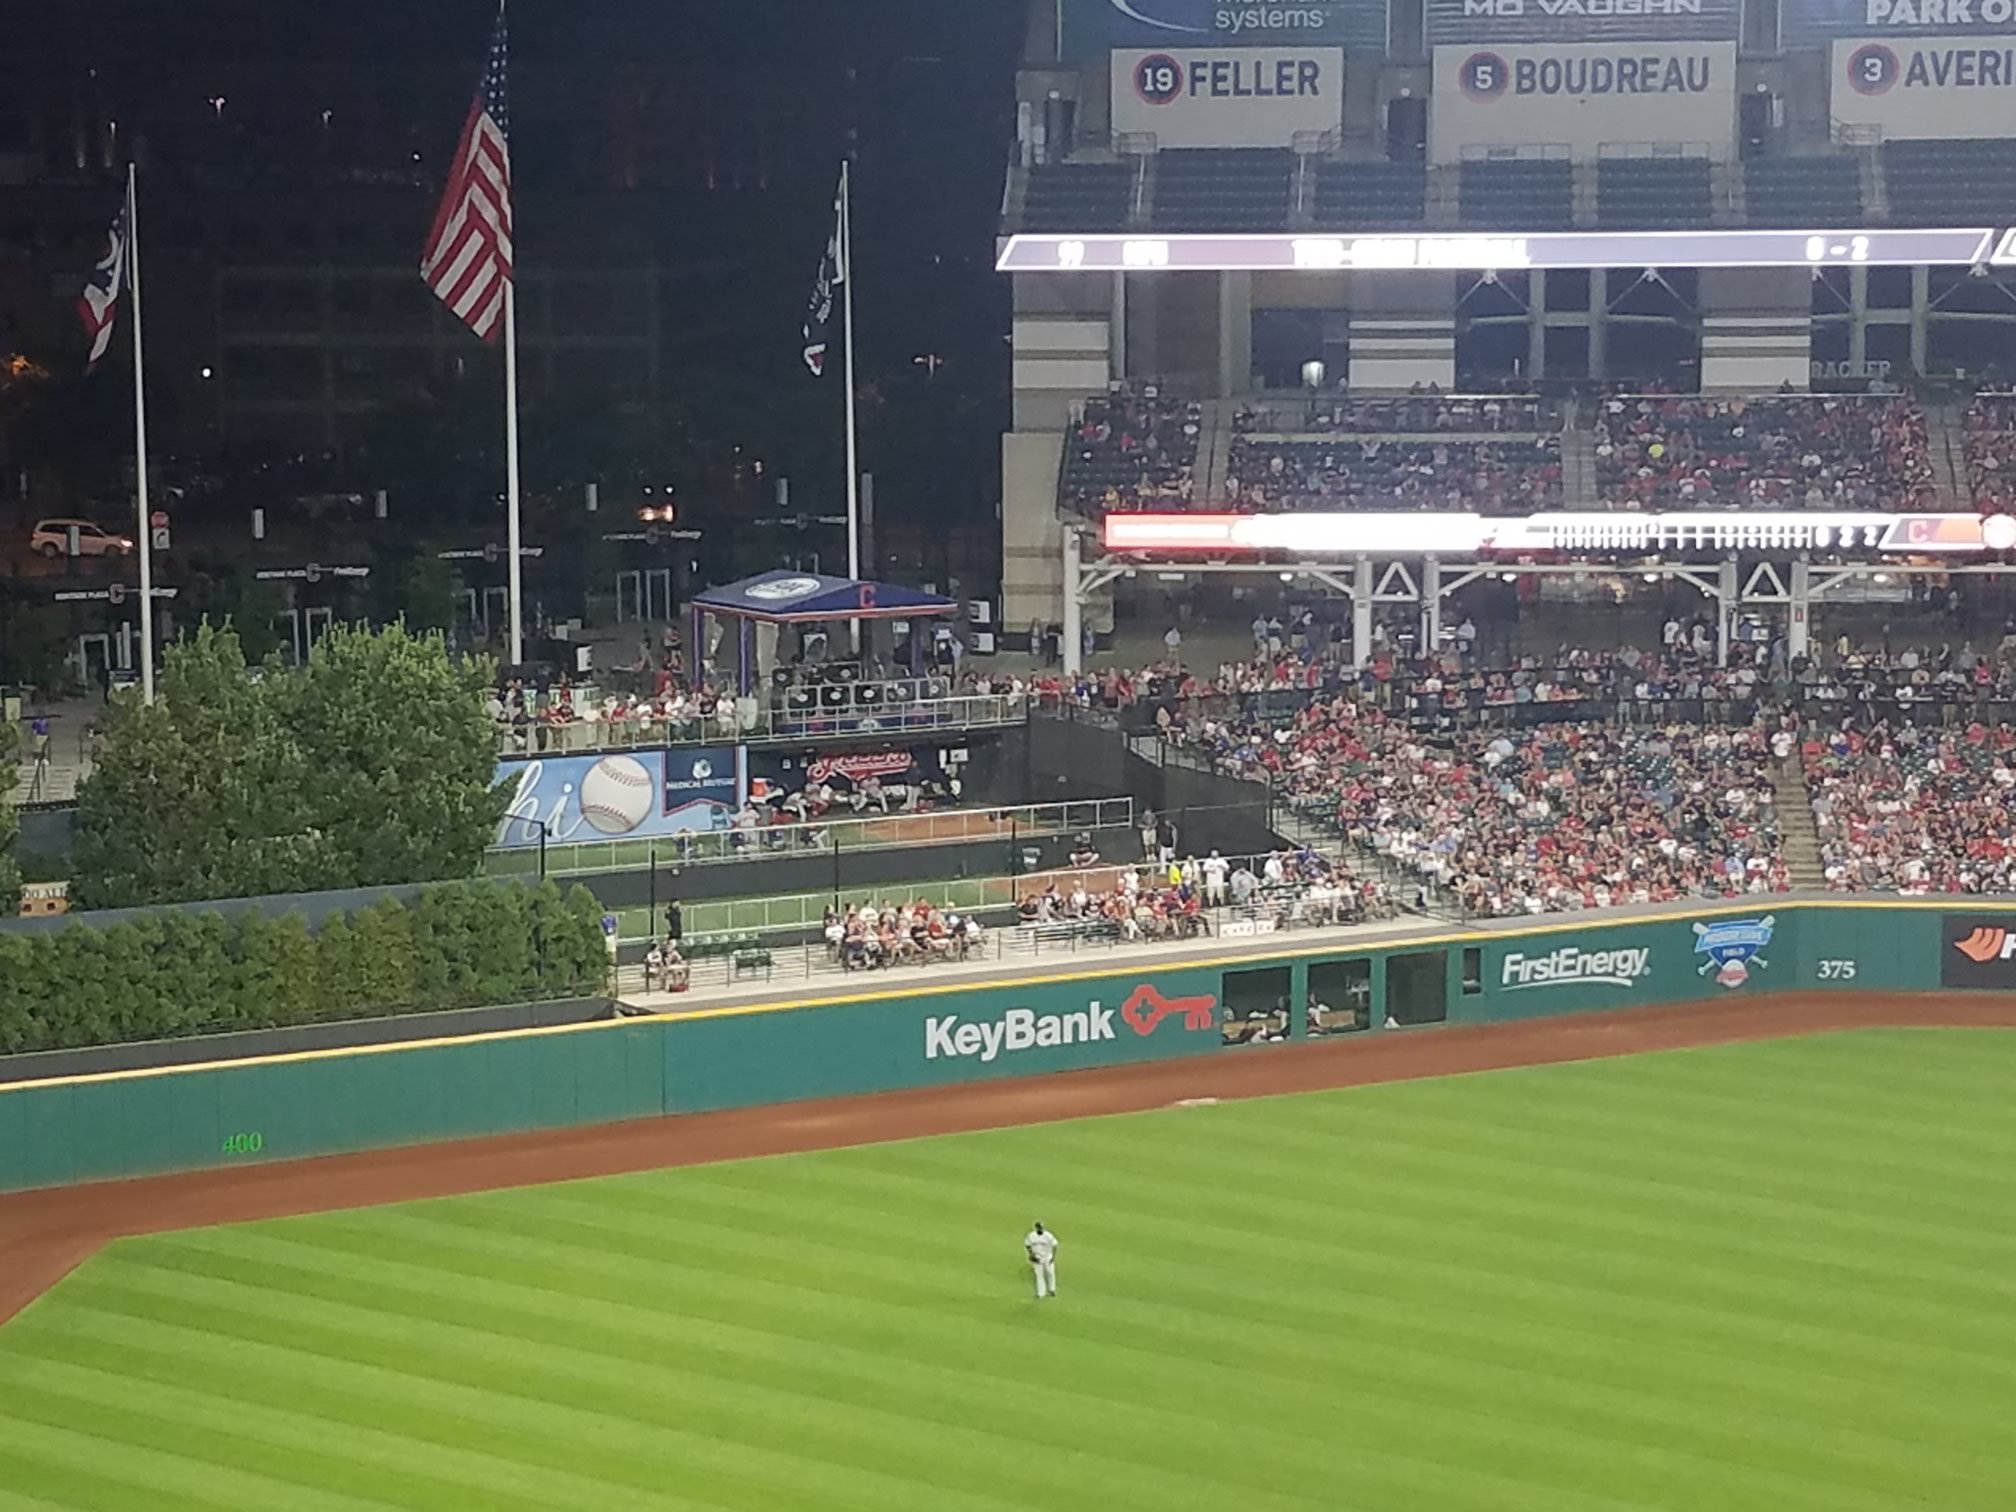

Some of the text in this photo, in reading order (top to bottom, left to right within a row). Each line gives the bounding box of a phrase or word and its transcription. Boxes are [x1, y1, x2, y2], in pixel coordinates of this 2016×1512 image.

[1215, 6, 1324, 34] systems
[1866, 0, 1973, 24] PARK
[1143, 60, 1320, 97] 19 FELLER
[1475, 56, 1710, 95] 5 BOUDREAU
[1864, 58, 1883, 81] 3
[1908, 520, 1929, 543] C
[860, 584, 876, 608] C
[1502, 948, 1650, 984] FirstEnergy
[1817, 960, 1856, 979] 375
[925, 1001, 1116, 1061] KeyBank
[222, 1131, 262, 1153] 400
